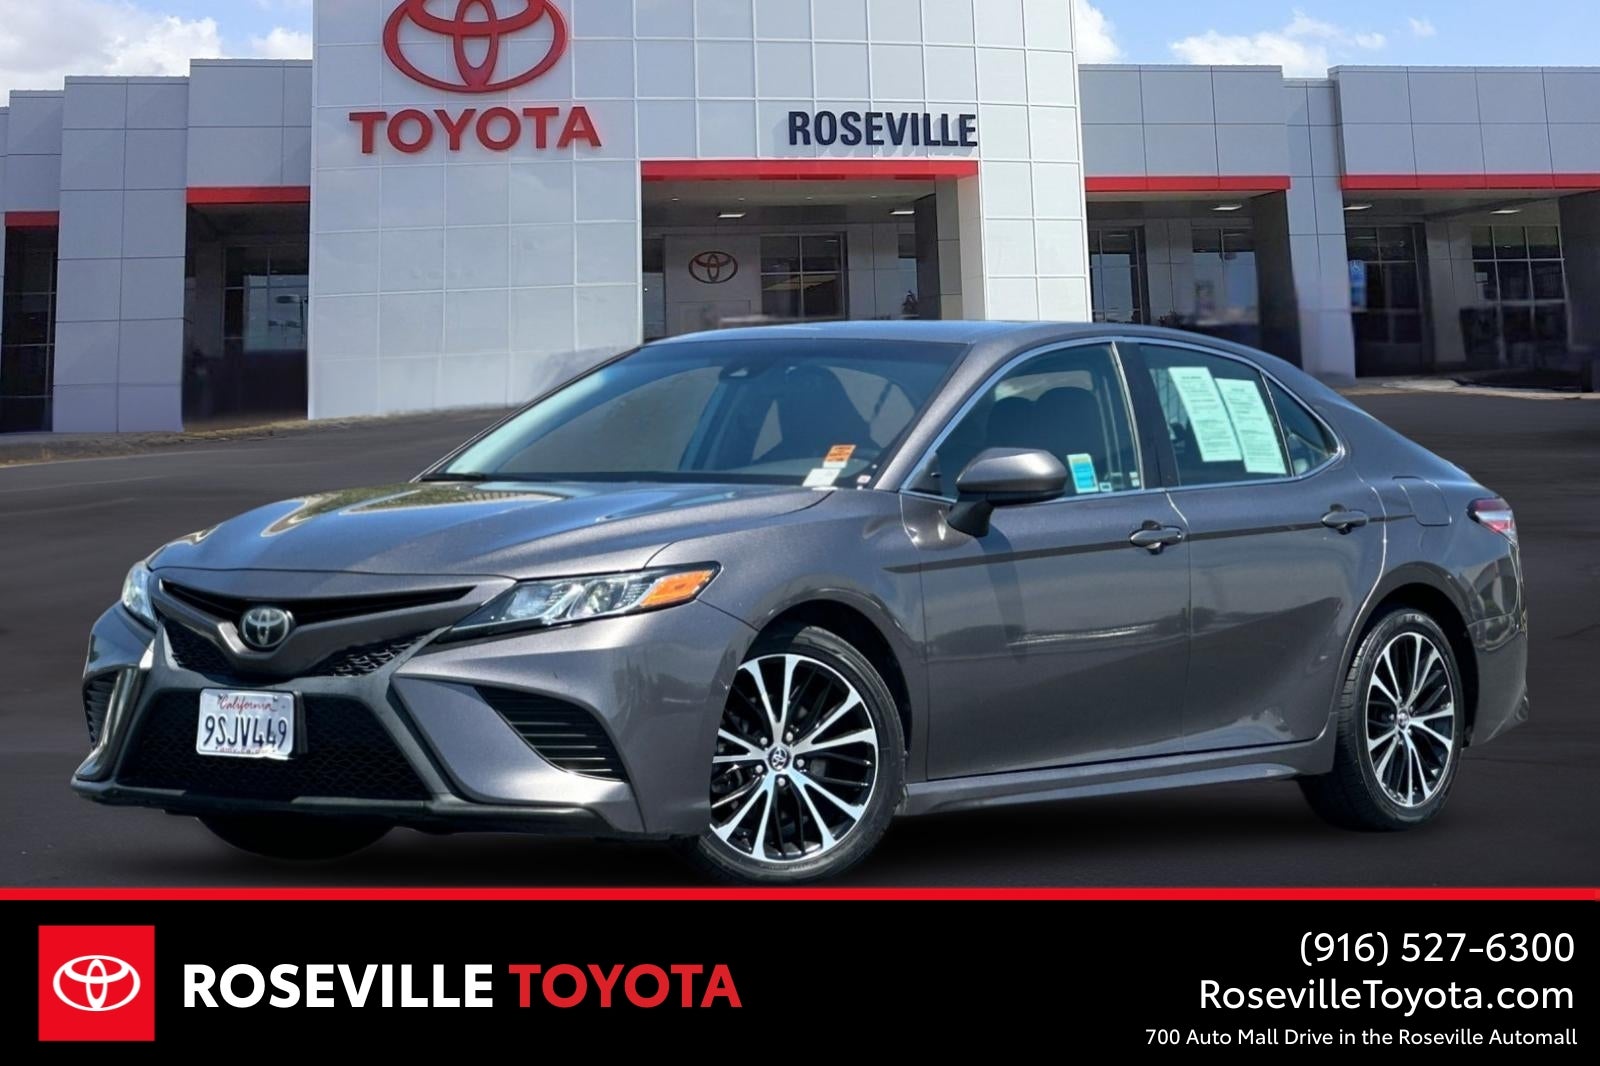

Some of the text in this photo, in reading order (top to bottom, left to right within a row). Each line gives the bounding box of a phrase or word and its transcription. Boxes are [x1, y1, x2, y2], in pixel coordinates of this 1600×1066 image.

[349, 106, 602, 154] TOYOTA
[788, 110, 978, 148] ROSEVILLE
[219, 695, 277, 713] California
[203, 714, 288, 750] 9SJV449
